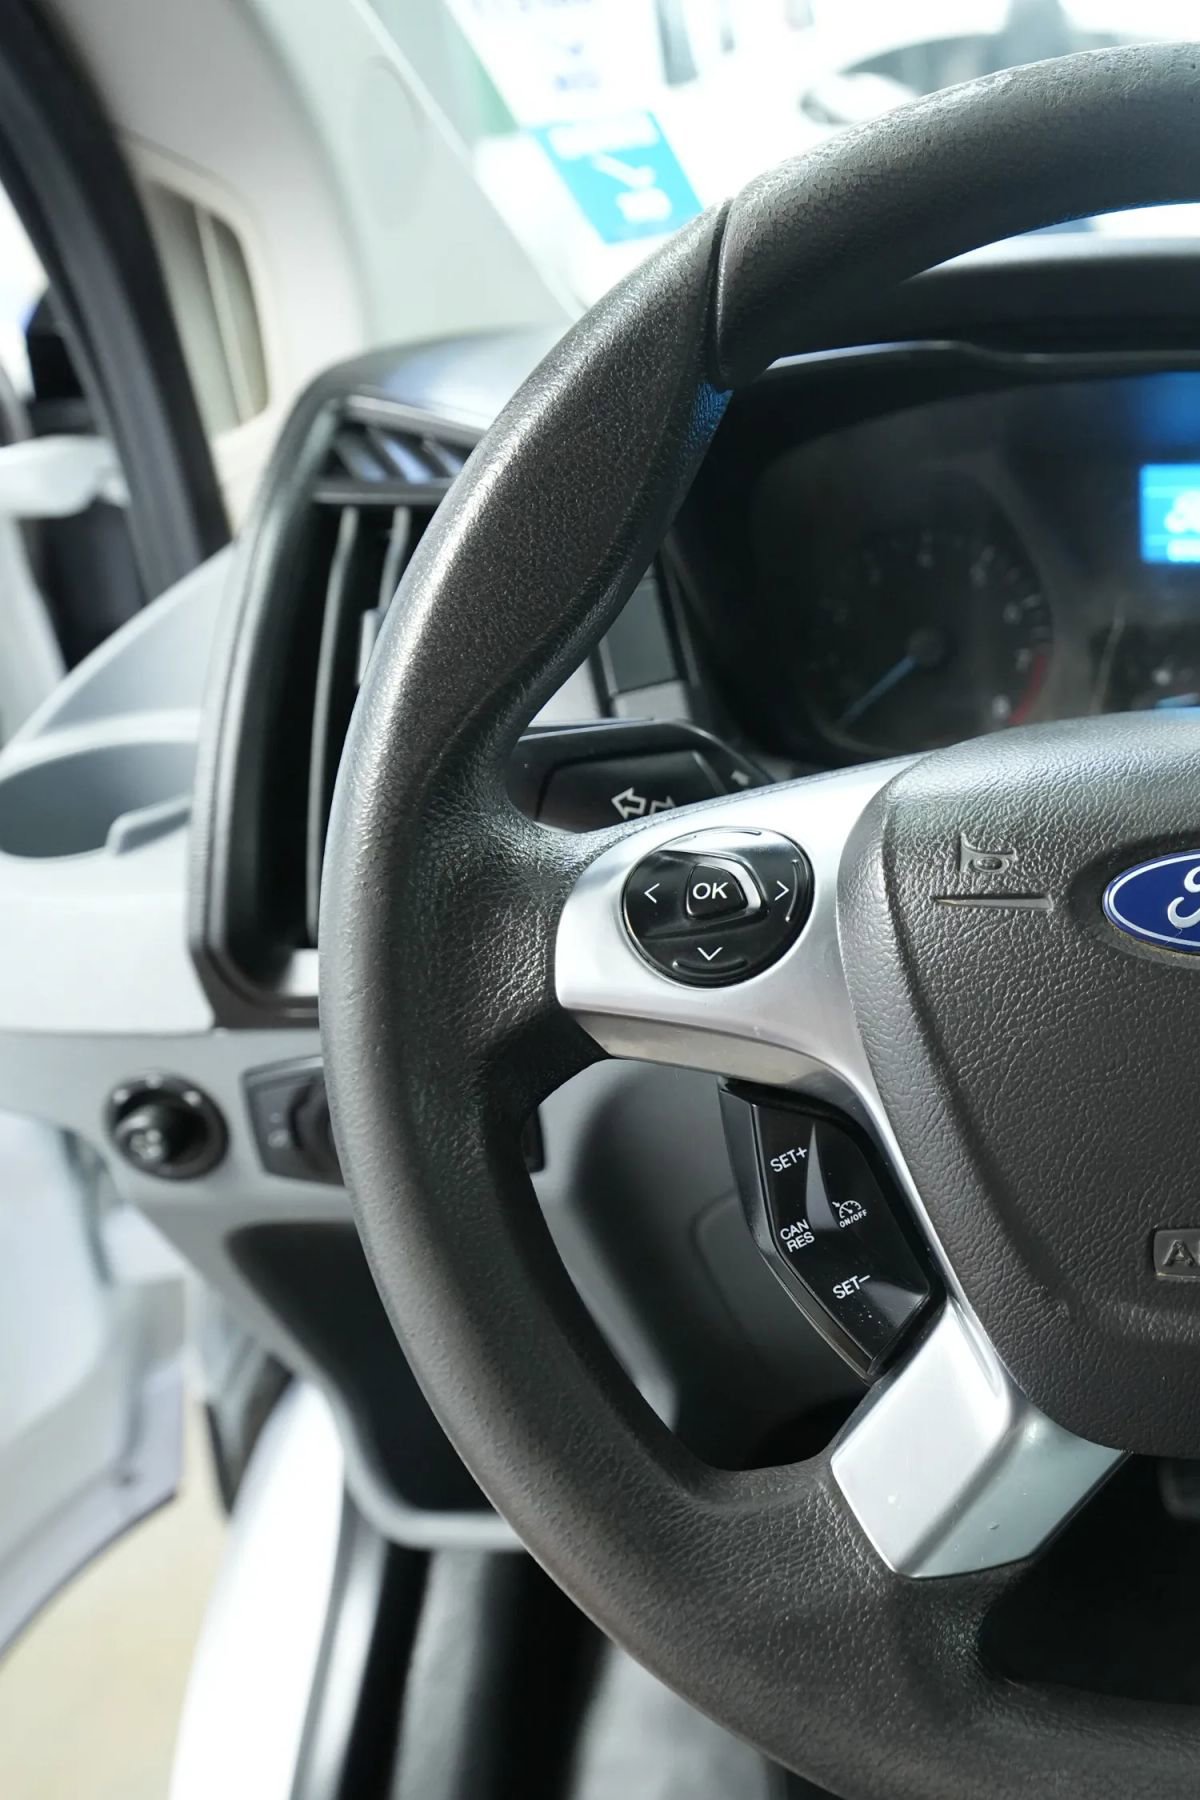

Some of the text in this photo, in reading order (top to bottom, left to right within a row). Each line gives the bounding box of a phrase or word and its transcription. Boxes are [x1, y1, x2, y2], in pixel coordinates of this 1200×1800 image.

[692, 882, 729, 900] OK
[770, 1147, 808, 1173] SET+
[839, 1209, 868, 1228] ON/OFF
[780, 1218, 810, 1241] CAN
[786, 1231, 815, 1252] RES
